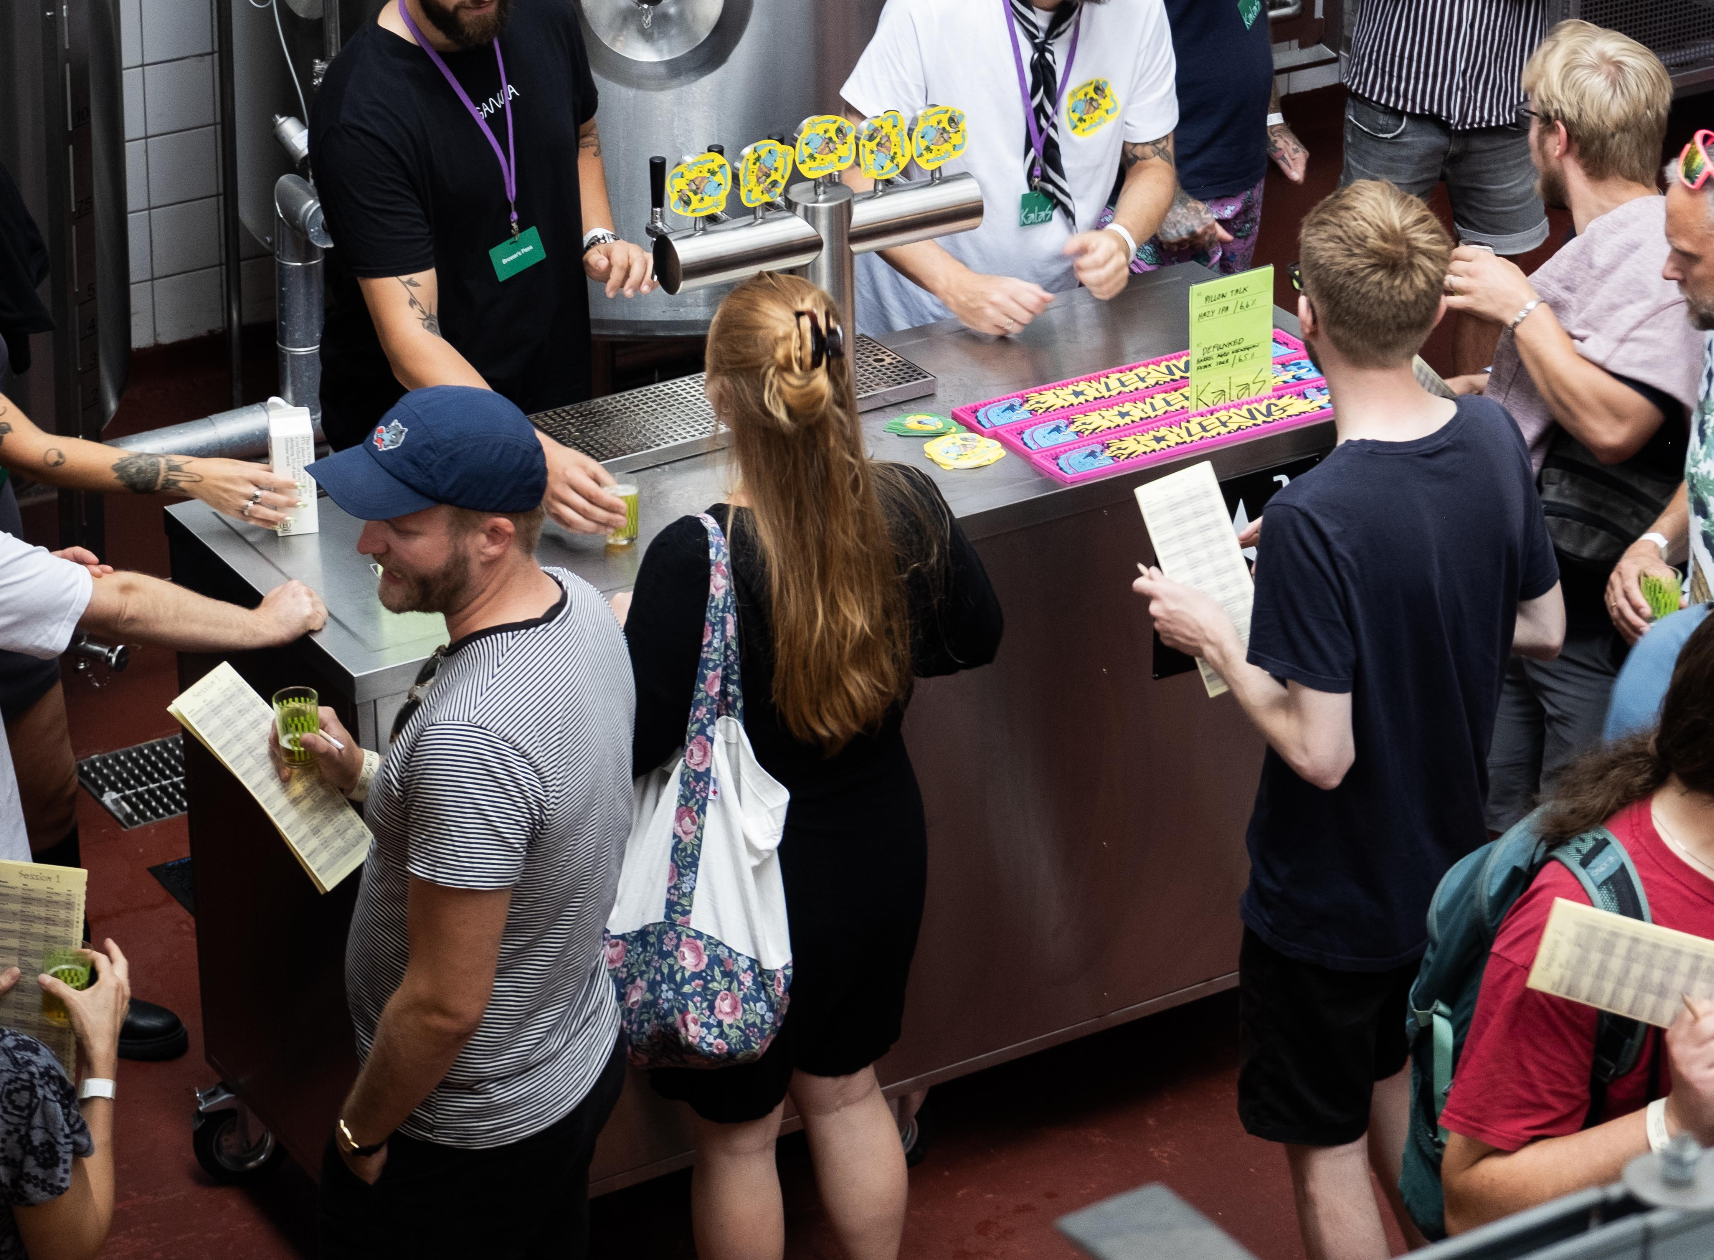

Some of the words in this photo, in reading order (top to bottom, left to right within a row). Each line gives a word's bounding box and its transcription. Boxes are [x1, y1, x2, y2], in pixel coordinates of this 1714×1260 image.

[76, 106, 89, 123] 10
[1230, 286, 1249, 297] TALK
[1197, 310, 1215, 321] HAZY
[1218, 305, 1229, 315] IPA
[1202, 337, 1245, 356] DEFUNKED
[1184, 402, 1294, 438] LERVIG
[18, 870, 52, 882] Session
